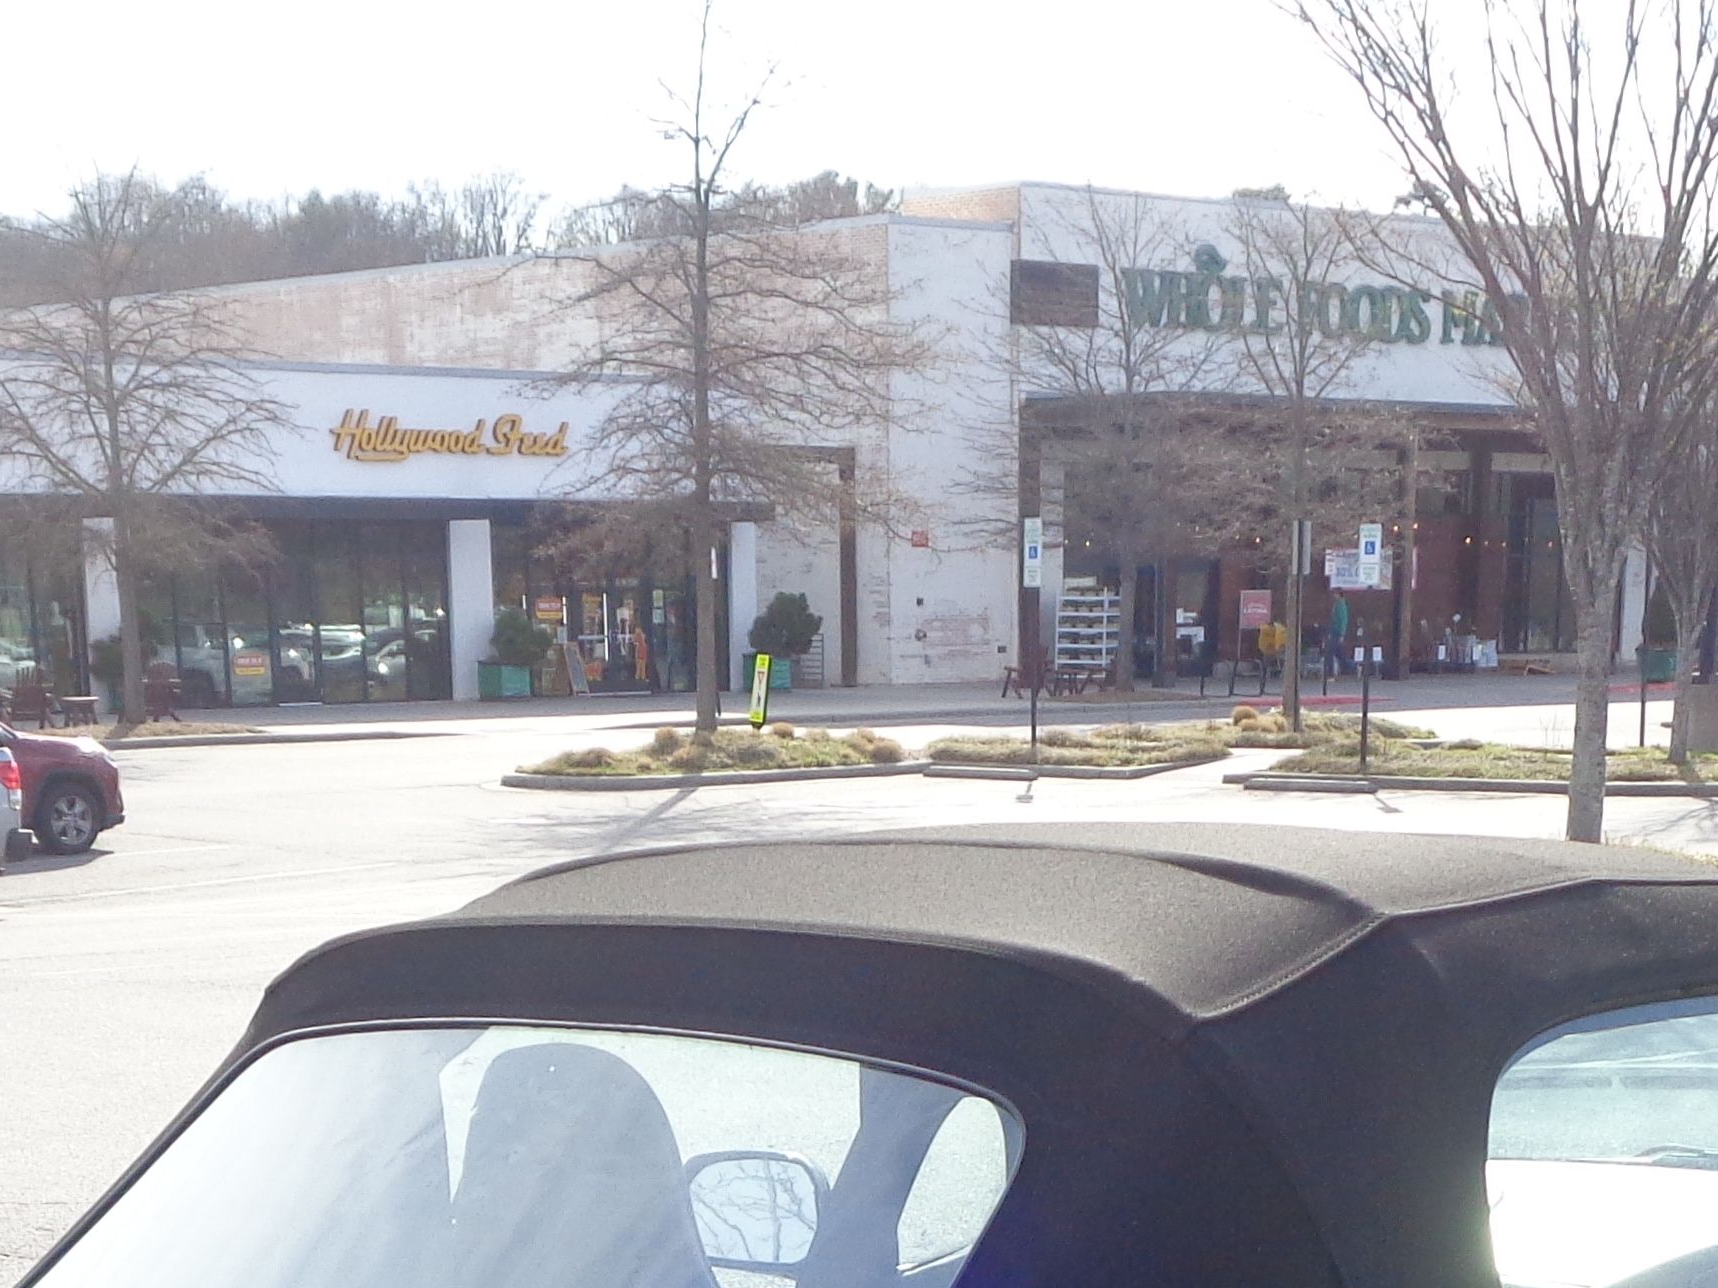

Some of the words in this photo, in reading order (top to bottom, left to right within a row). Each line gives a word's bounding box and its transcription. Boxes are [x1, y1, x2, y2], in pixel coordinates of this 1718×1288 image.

[1121, 268, 1284, 335] WHOLE
[1296, 281, 1432, 345] FOODS
[329, 408, 487, 462] Hollywood
[486, 412, 570, 456] Feed
